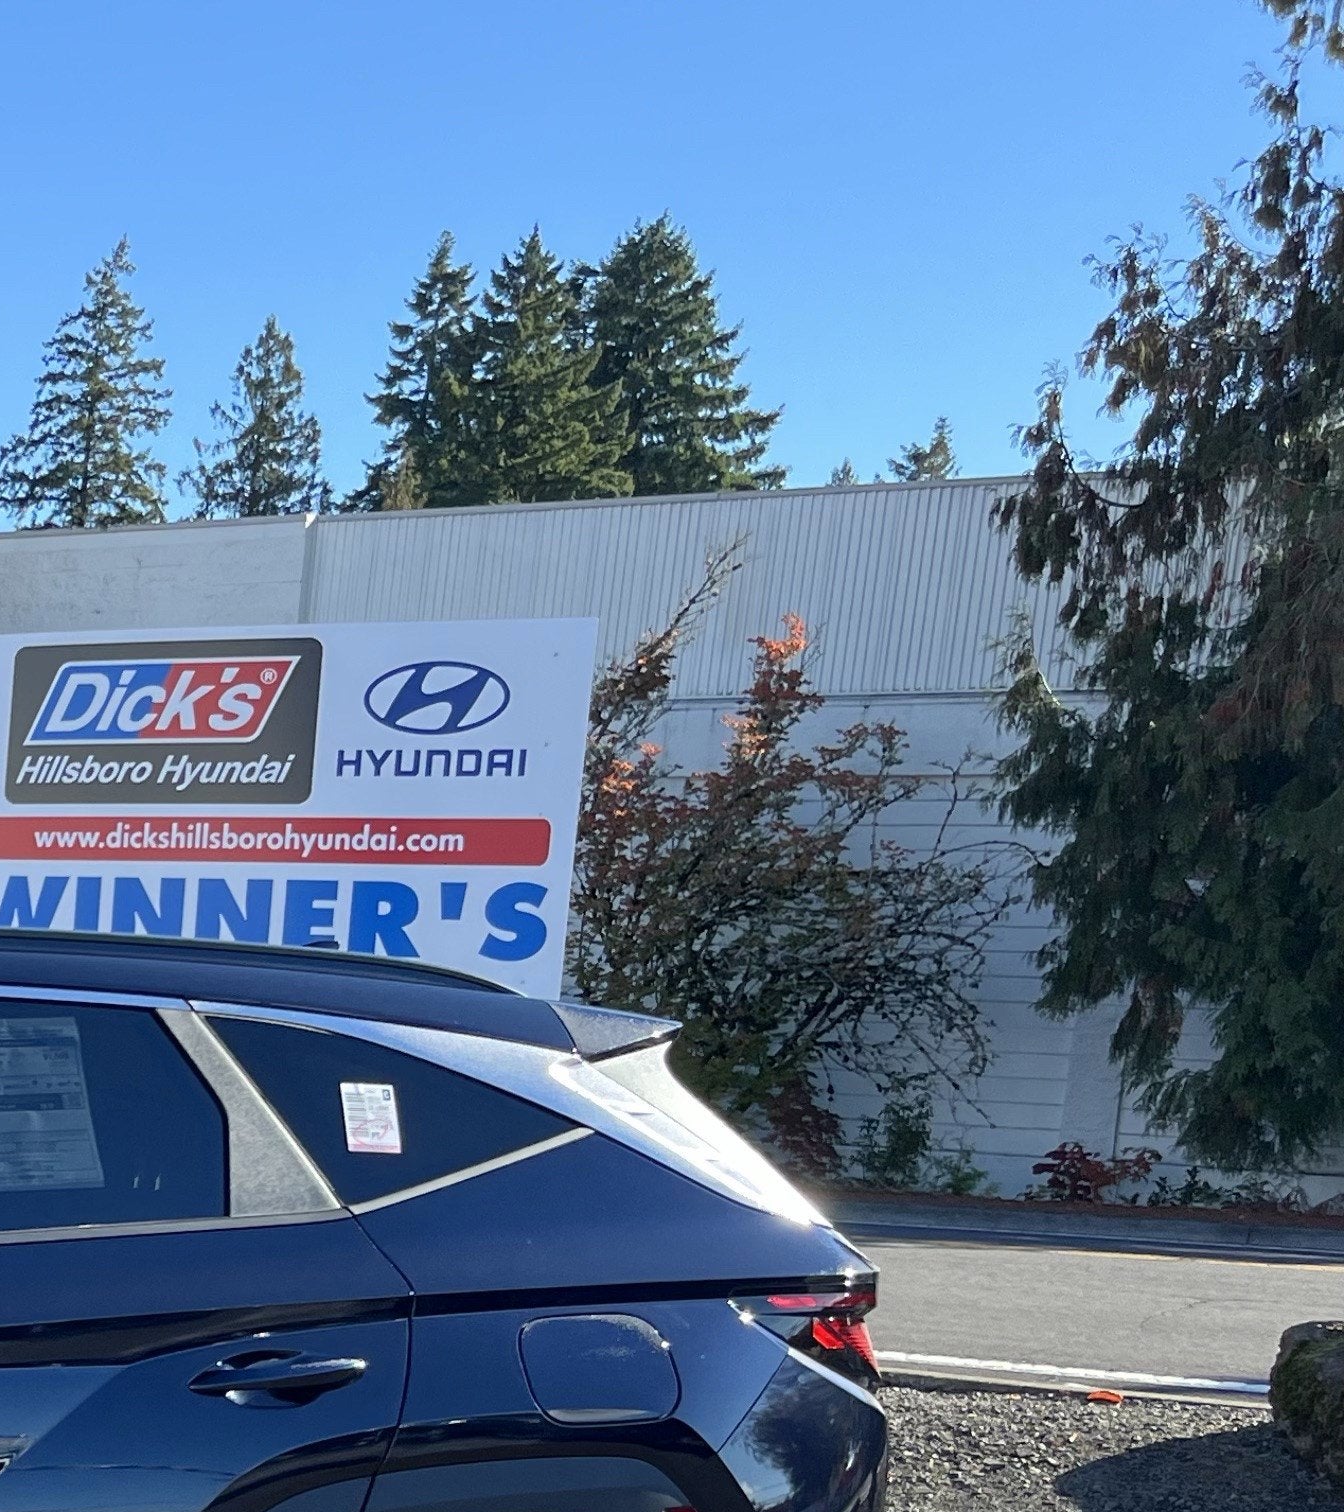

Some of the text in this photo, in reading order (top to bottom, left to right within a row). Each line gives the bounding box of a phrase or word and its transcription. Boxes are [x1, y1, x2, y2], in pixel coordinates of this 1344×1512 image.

[44, 667, 263, 733] Dick's
[15, 753, 296, 791] Hillsboro Hyundai
[336, 749, 528, 778] HYUNDAI
[33, 822, 465, 859] www.dickshillsborohyundai.com
